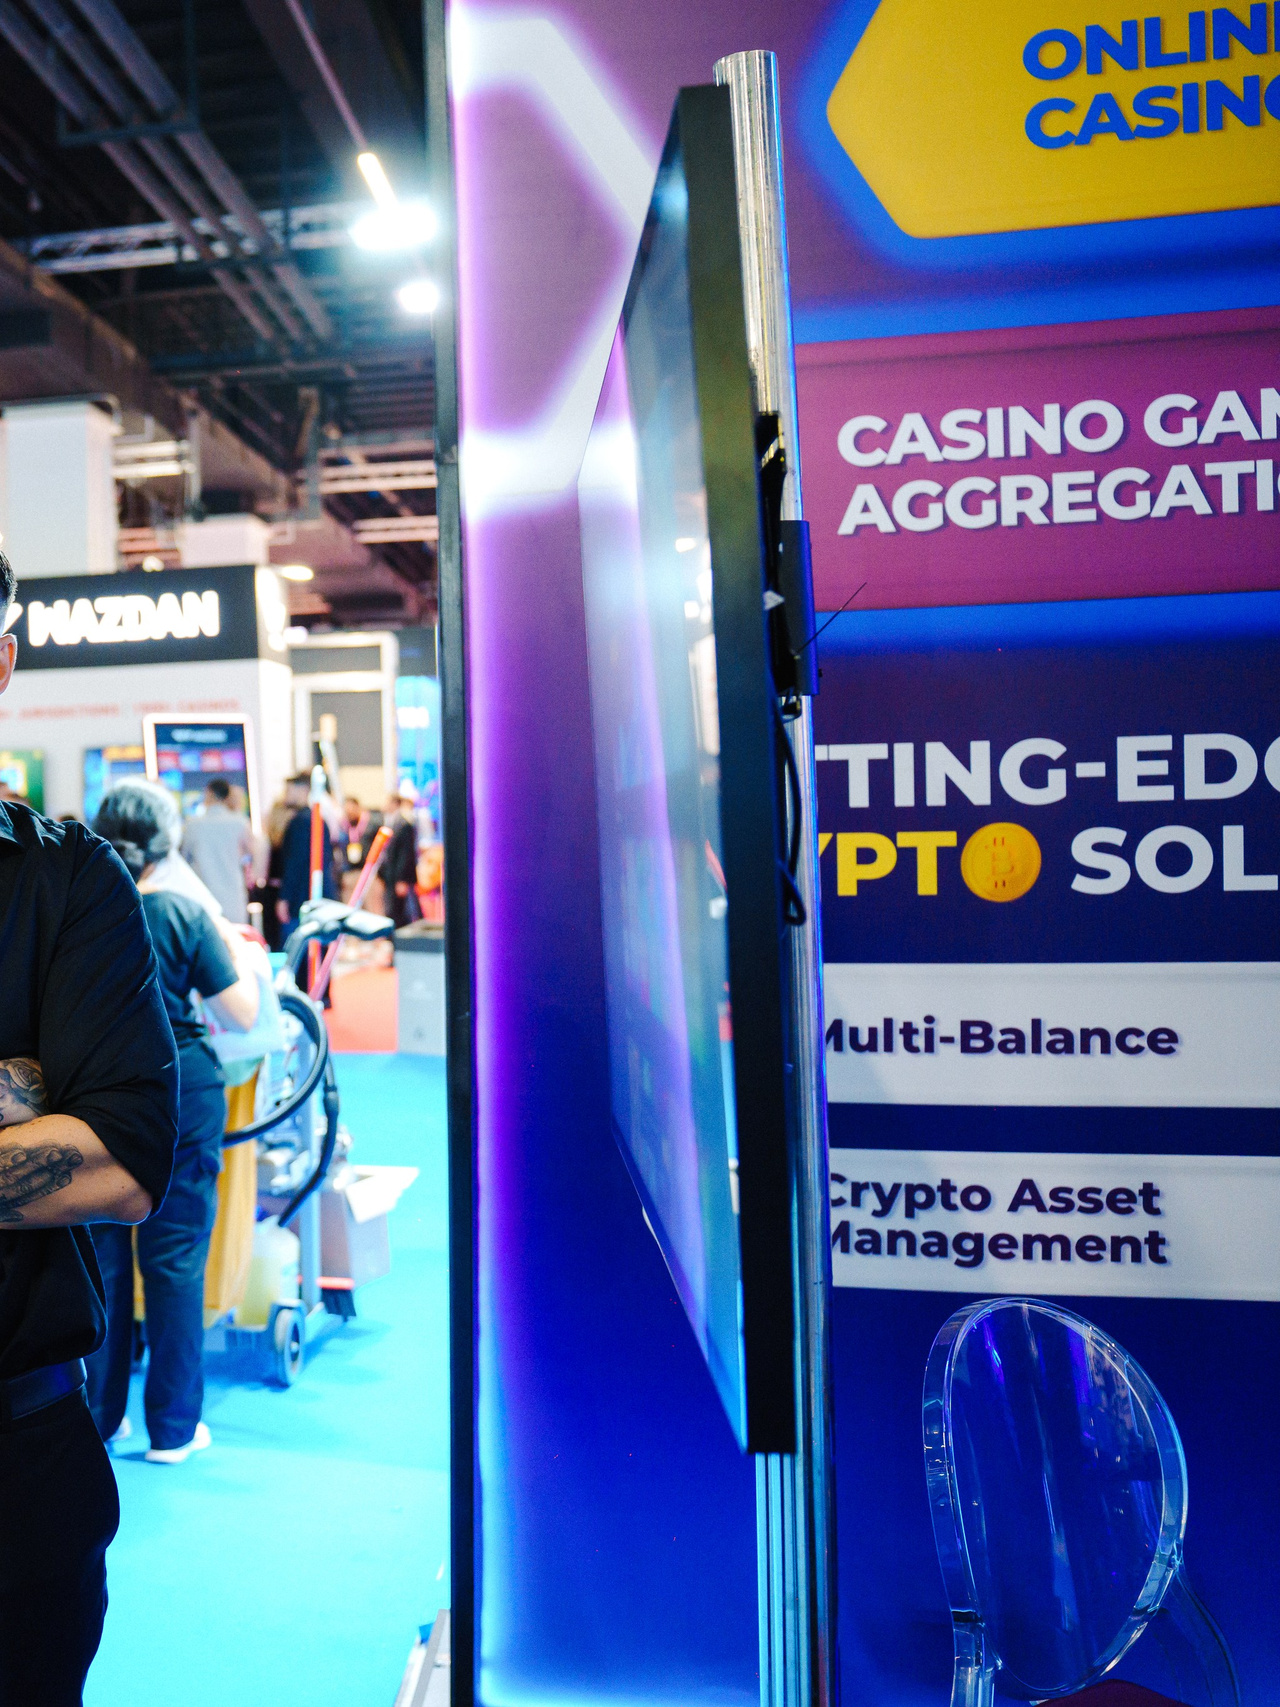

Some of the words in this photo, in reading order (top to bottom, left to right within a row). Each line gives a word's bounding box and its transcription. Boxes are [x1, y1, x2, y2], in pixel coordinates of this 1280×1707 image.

[1023, 1, 1280, 80] ONLIN
[1025, 74, 1280, 149] CASIN
[837, 400, 1124, 467] CASINO
[837, 459, 1280, 535] AGGREGATI
[815, 733, 1280, 808] TING-ED
[1070, 825, 1279, 895] SOL
[1008, 1178, 1163, 1215] Asset
